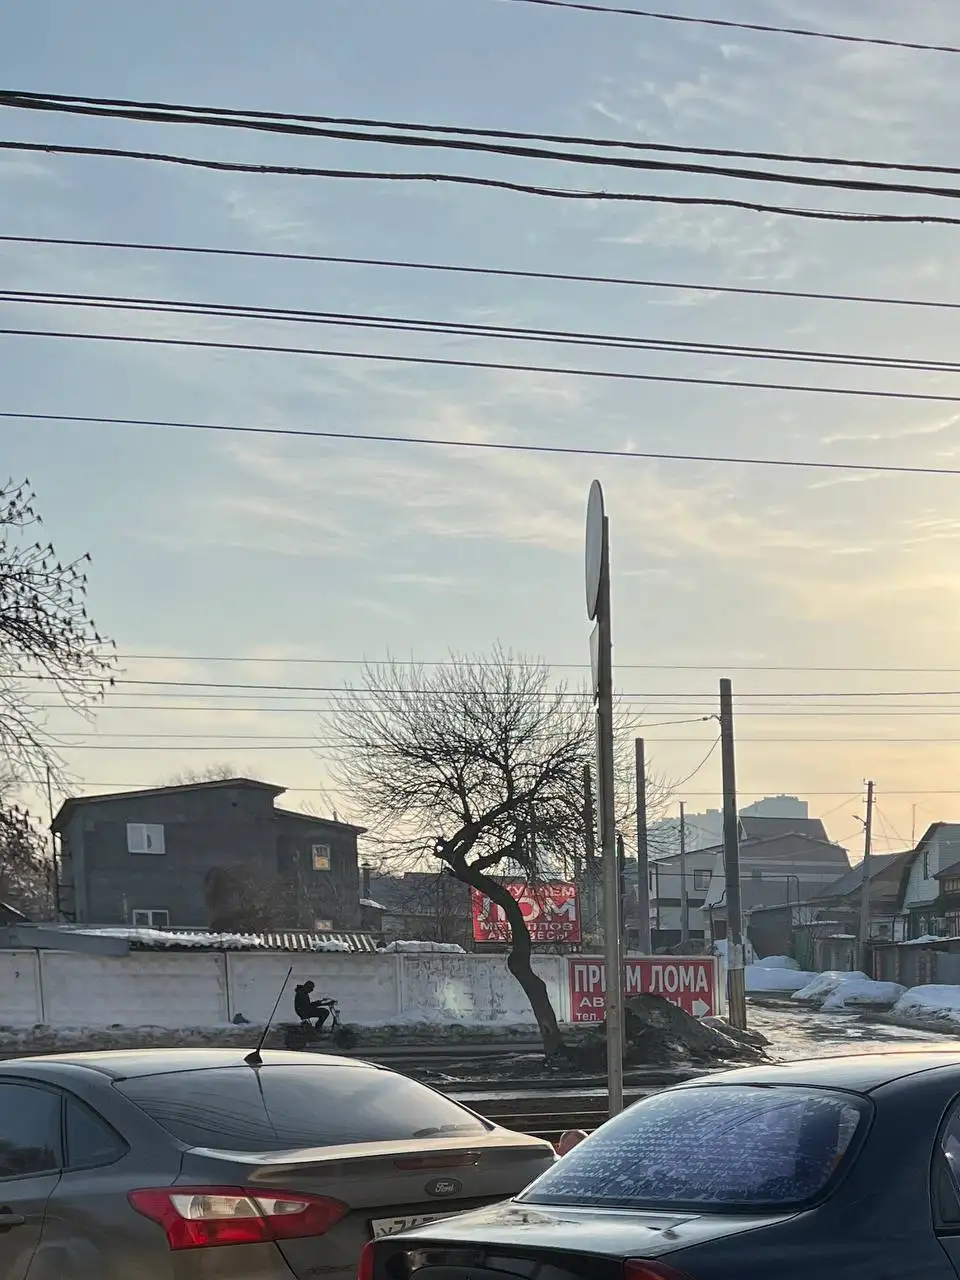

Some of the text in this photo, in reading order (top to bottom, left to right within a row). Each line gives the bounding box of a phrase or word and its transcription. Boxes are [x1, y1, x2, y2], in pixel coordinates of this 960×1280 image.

[477, 897, 576, 922] ЛОМ
[480, 921, 574, 931] МЕТЛЛОВ
[574, 964, 709, 993] ПРМ ЛОМА
[435, 1182, 455, 1193] Ford
